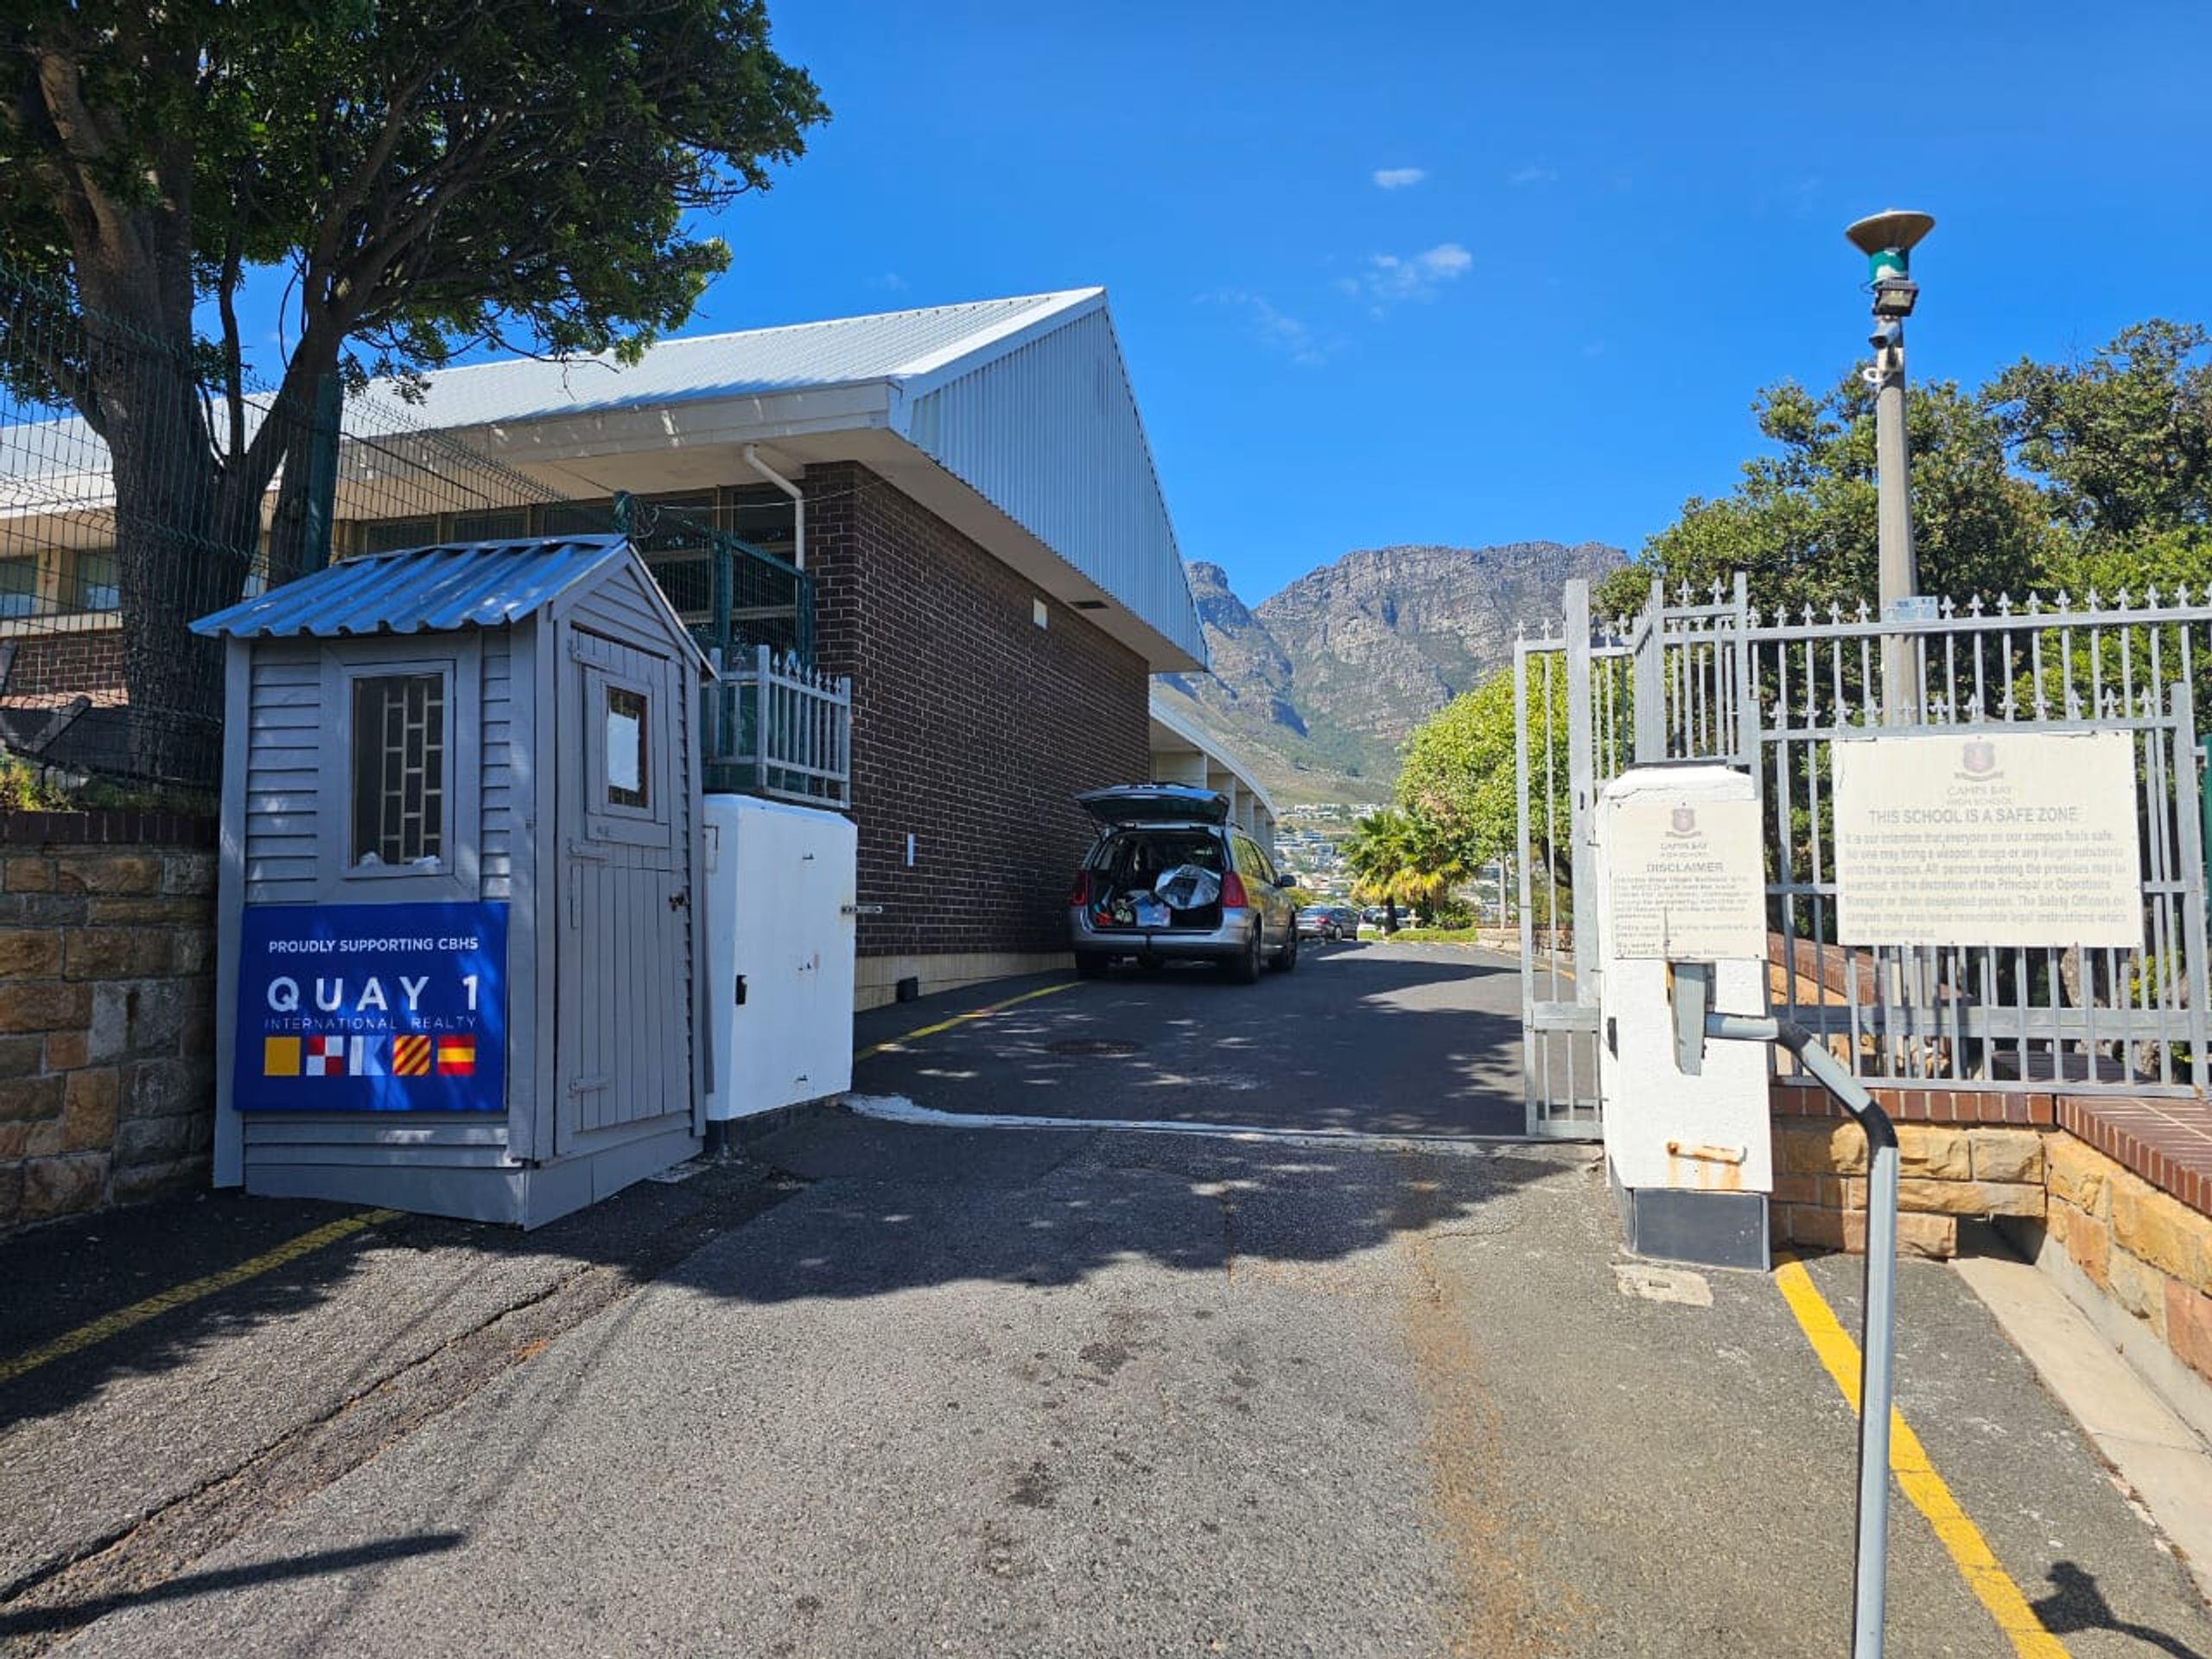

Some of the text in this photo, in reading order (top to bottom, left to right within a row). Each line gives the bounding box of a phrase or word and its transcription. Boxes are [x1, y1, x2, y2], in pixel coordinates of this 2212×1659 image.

[1869, 807, 2079, 824] THIS SCHOOL IS A SAFE ZONE
[1646, 861, 1725, 874] DISCLAIMER
[269, 938, 479, 954] PROUDLY SUPPORTING CBHS
[267, 976, 478, 1012] QUAY 1
[264, 1017, 476, 1030] INTERNATIONAL REALTY
